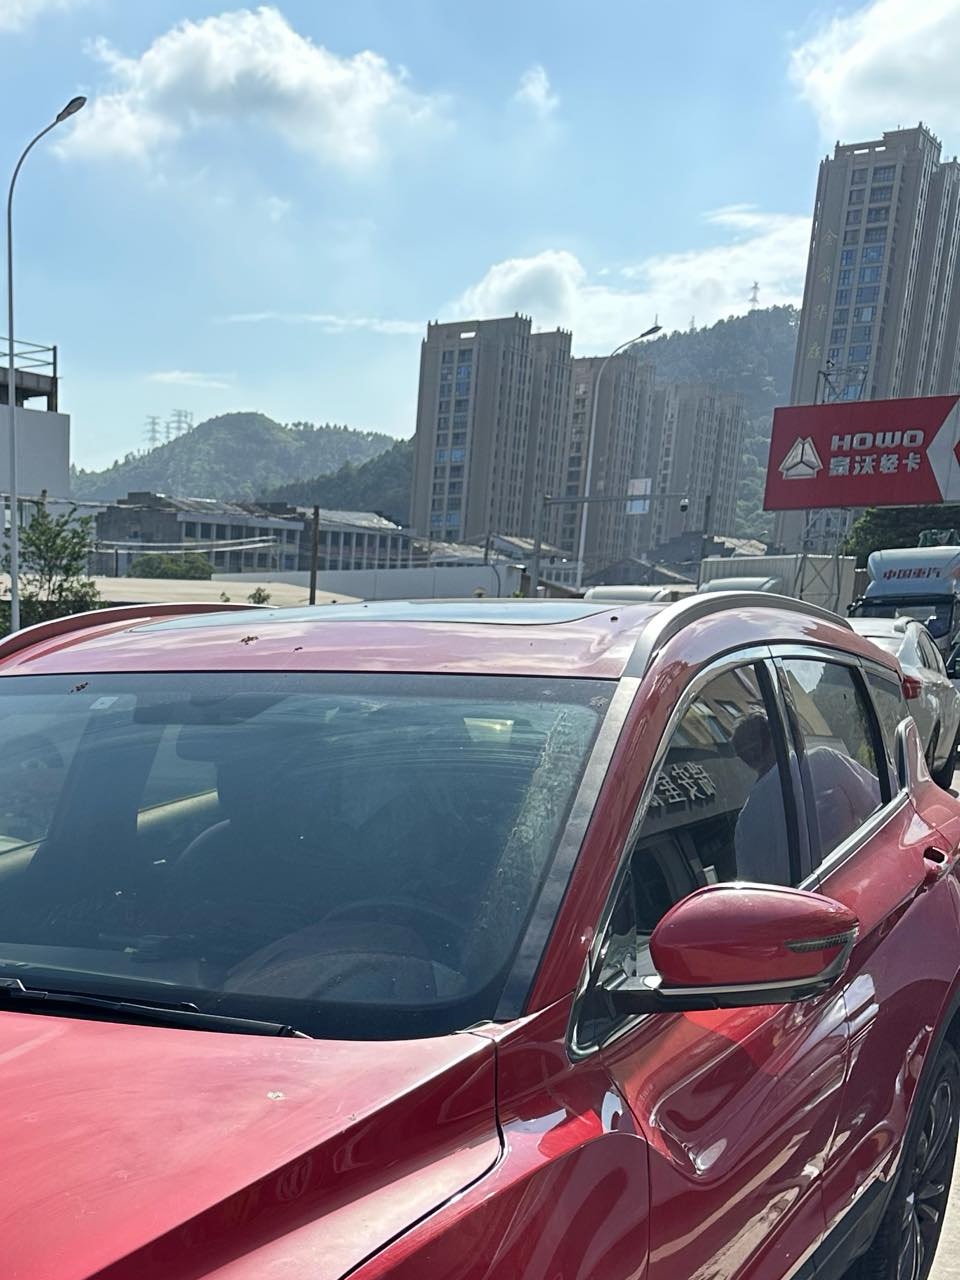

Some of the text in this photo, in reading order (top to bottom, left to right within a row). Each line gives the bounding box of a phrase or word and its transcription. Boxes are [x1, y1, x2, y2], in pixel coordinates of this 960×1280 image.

[829, 430, 924, 451] HOWO
[829, 452, 921, 477] 豪沃轻卡
[883, 567, 941, 580] 中国重汽
